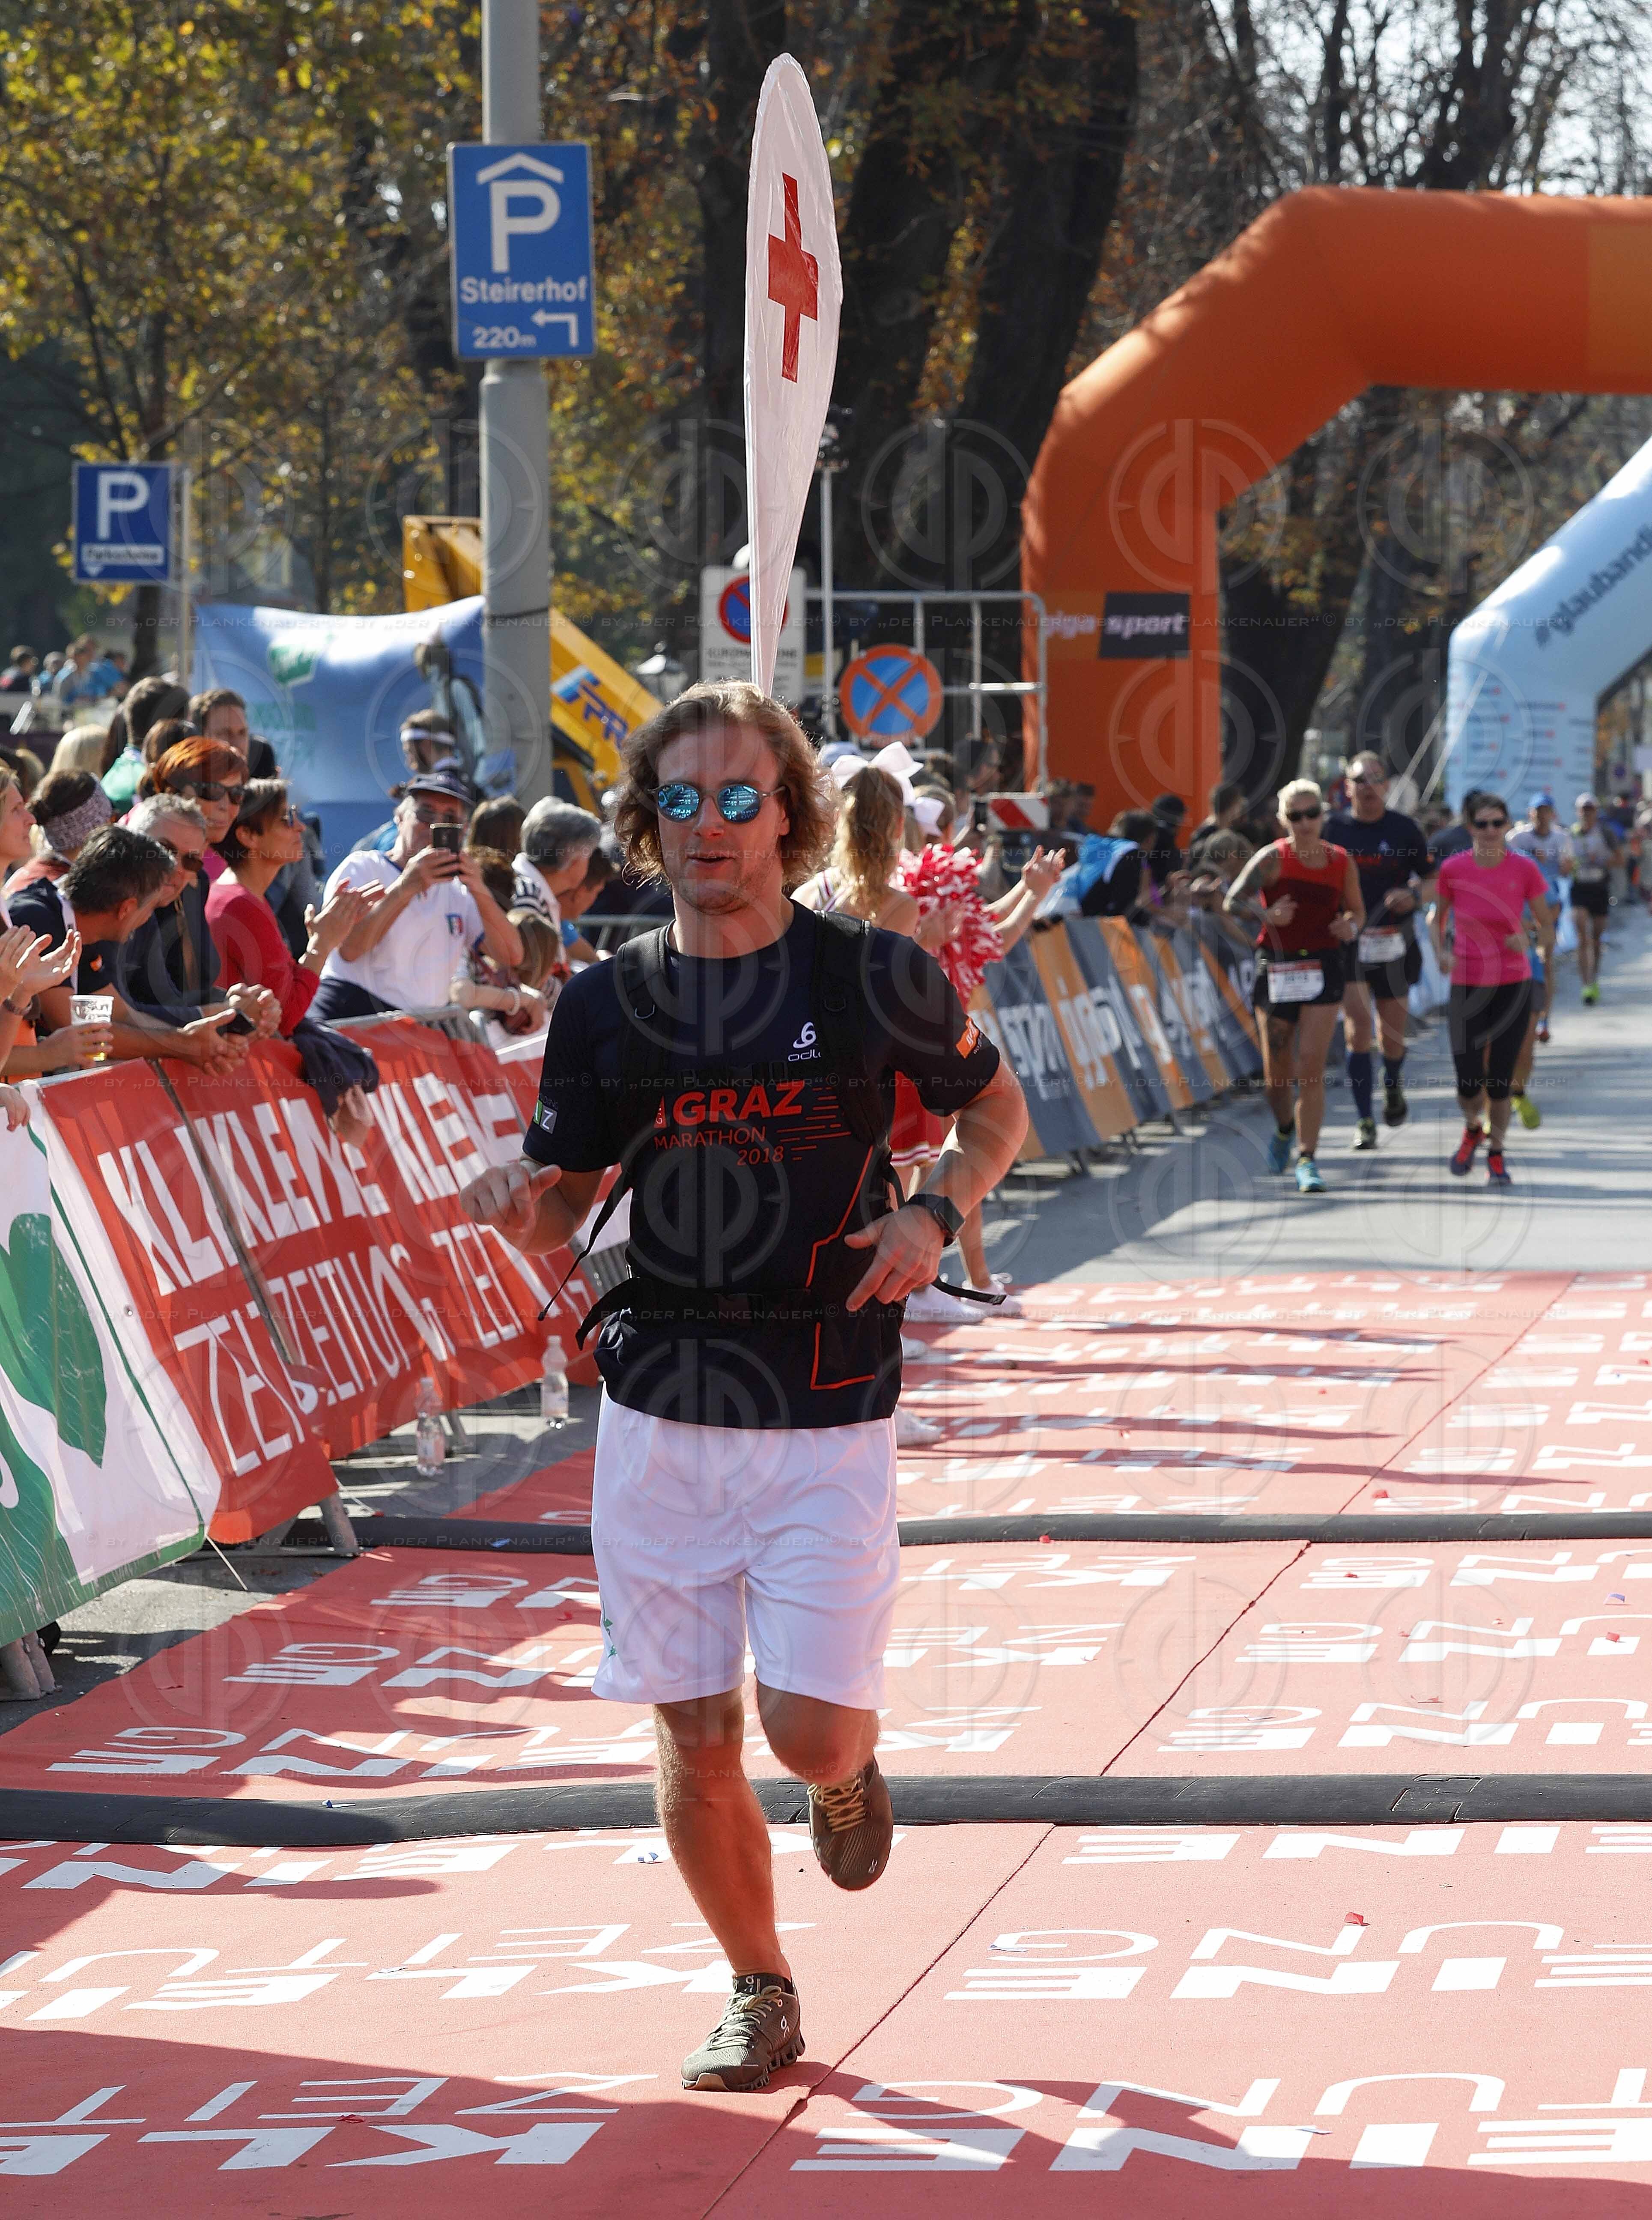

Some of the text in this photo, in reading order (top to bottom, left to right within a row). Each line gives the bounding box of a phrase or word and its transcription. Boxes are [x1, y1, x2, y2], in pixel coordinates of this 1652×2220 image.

[489, 180, 561, 274] P
[459, 276, 588, 304] Steirerhof
[472, 326, 537, 349] 220m
[97, 471, 150, 541] P
[1106, 613, 1185, 639] sport
[673, 1080, 805, 1126] GRAZ
[654, 1127, 766, 1150] MARATHON
[737, 1146, 784, 1166] 2018
